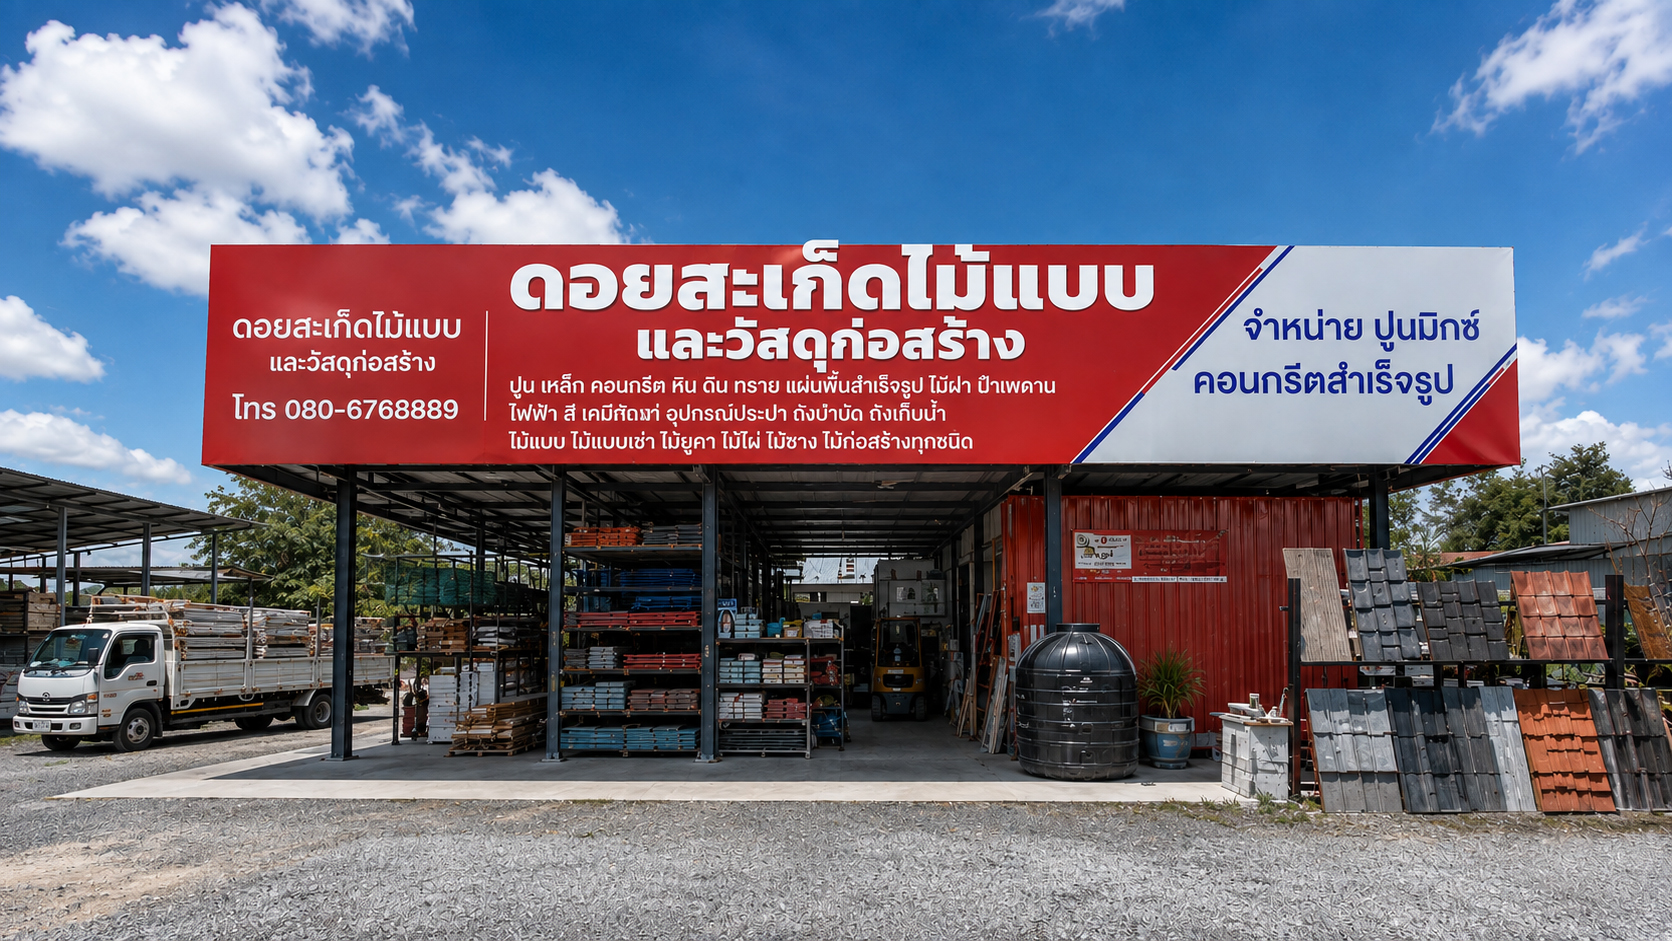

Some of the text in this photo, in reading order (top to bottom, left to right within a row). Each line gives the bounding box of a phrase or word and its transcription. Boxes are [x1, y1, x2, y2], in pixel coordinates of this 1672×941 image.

[510, 240, 1156, 312] ดอยสะเก็ดไม้แบบ
[232, 309, 462, 339] ดอยสะเก็ดไม้แบบ
[1244, 308, 1480, 352] จำหน่าย ปูนมิกซ์
[637, 316, 1026, 374] และวัสดุก่อสร้าง
[269, 350, 436, 379] และวัสดุก่อสร้าง
[509, 376, 535, 399] ปูน
[541, 374, 585, 394] เหล็ก
[591, 375, 666, 394] คอนกรีต
[734, 380, 780, 394] ทราย
[1194, 359, 1454, 406] คอนกรีตสำเร็จรูป
[231, 393, 459, 420] โทร 080-6768889
[508, 403, 558, 422] ไฟฟ้า
[665, 403, 787, 427] อุปกรณ์ประปา
[869, 400, 947, 422] ถังเก็บน้ำ
[508, 430, 566, 450] ไม้แบบ
[570, 430, 655, 450] ไม้แบบเช่า
[659, 430, 716, 455] ไม้ยูคา
[720, 430, 761, 450] ไม้ไผ่
[765, 430, 818, 450] ไม้ซาง
